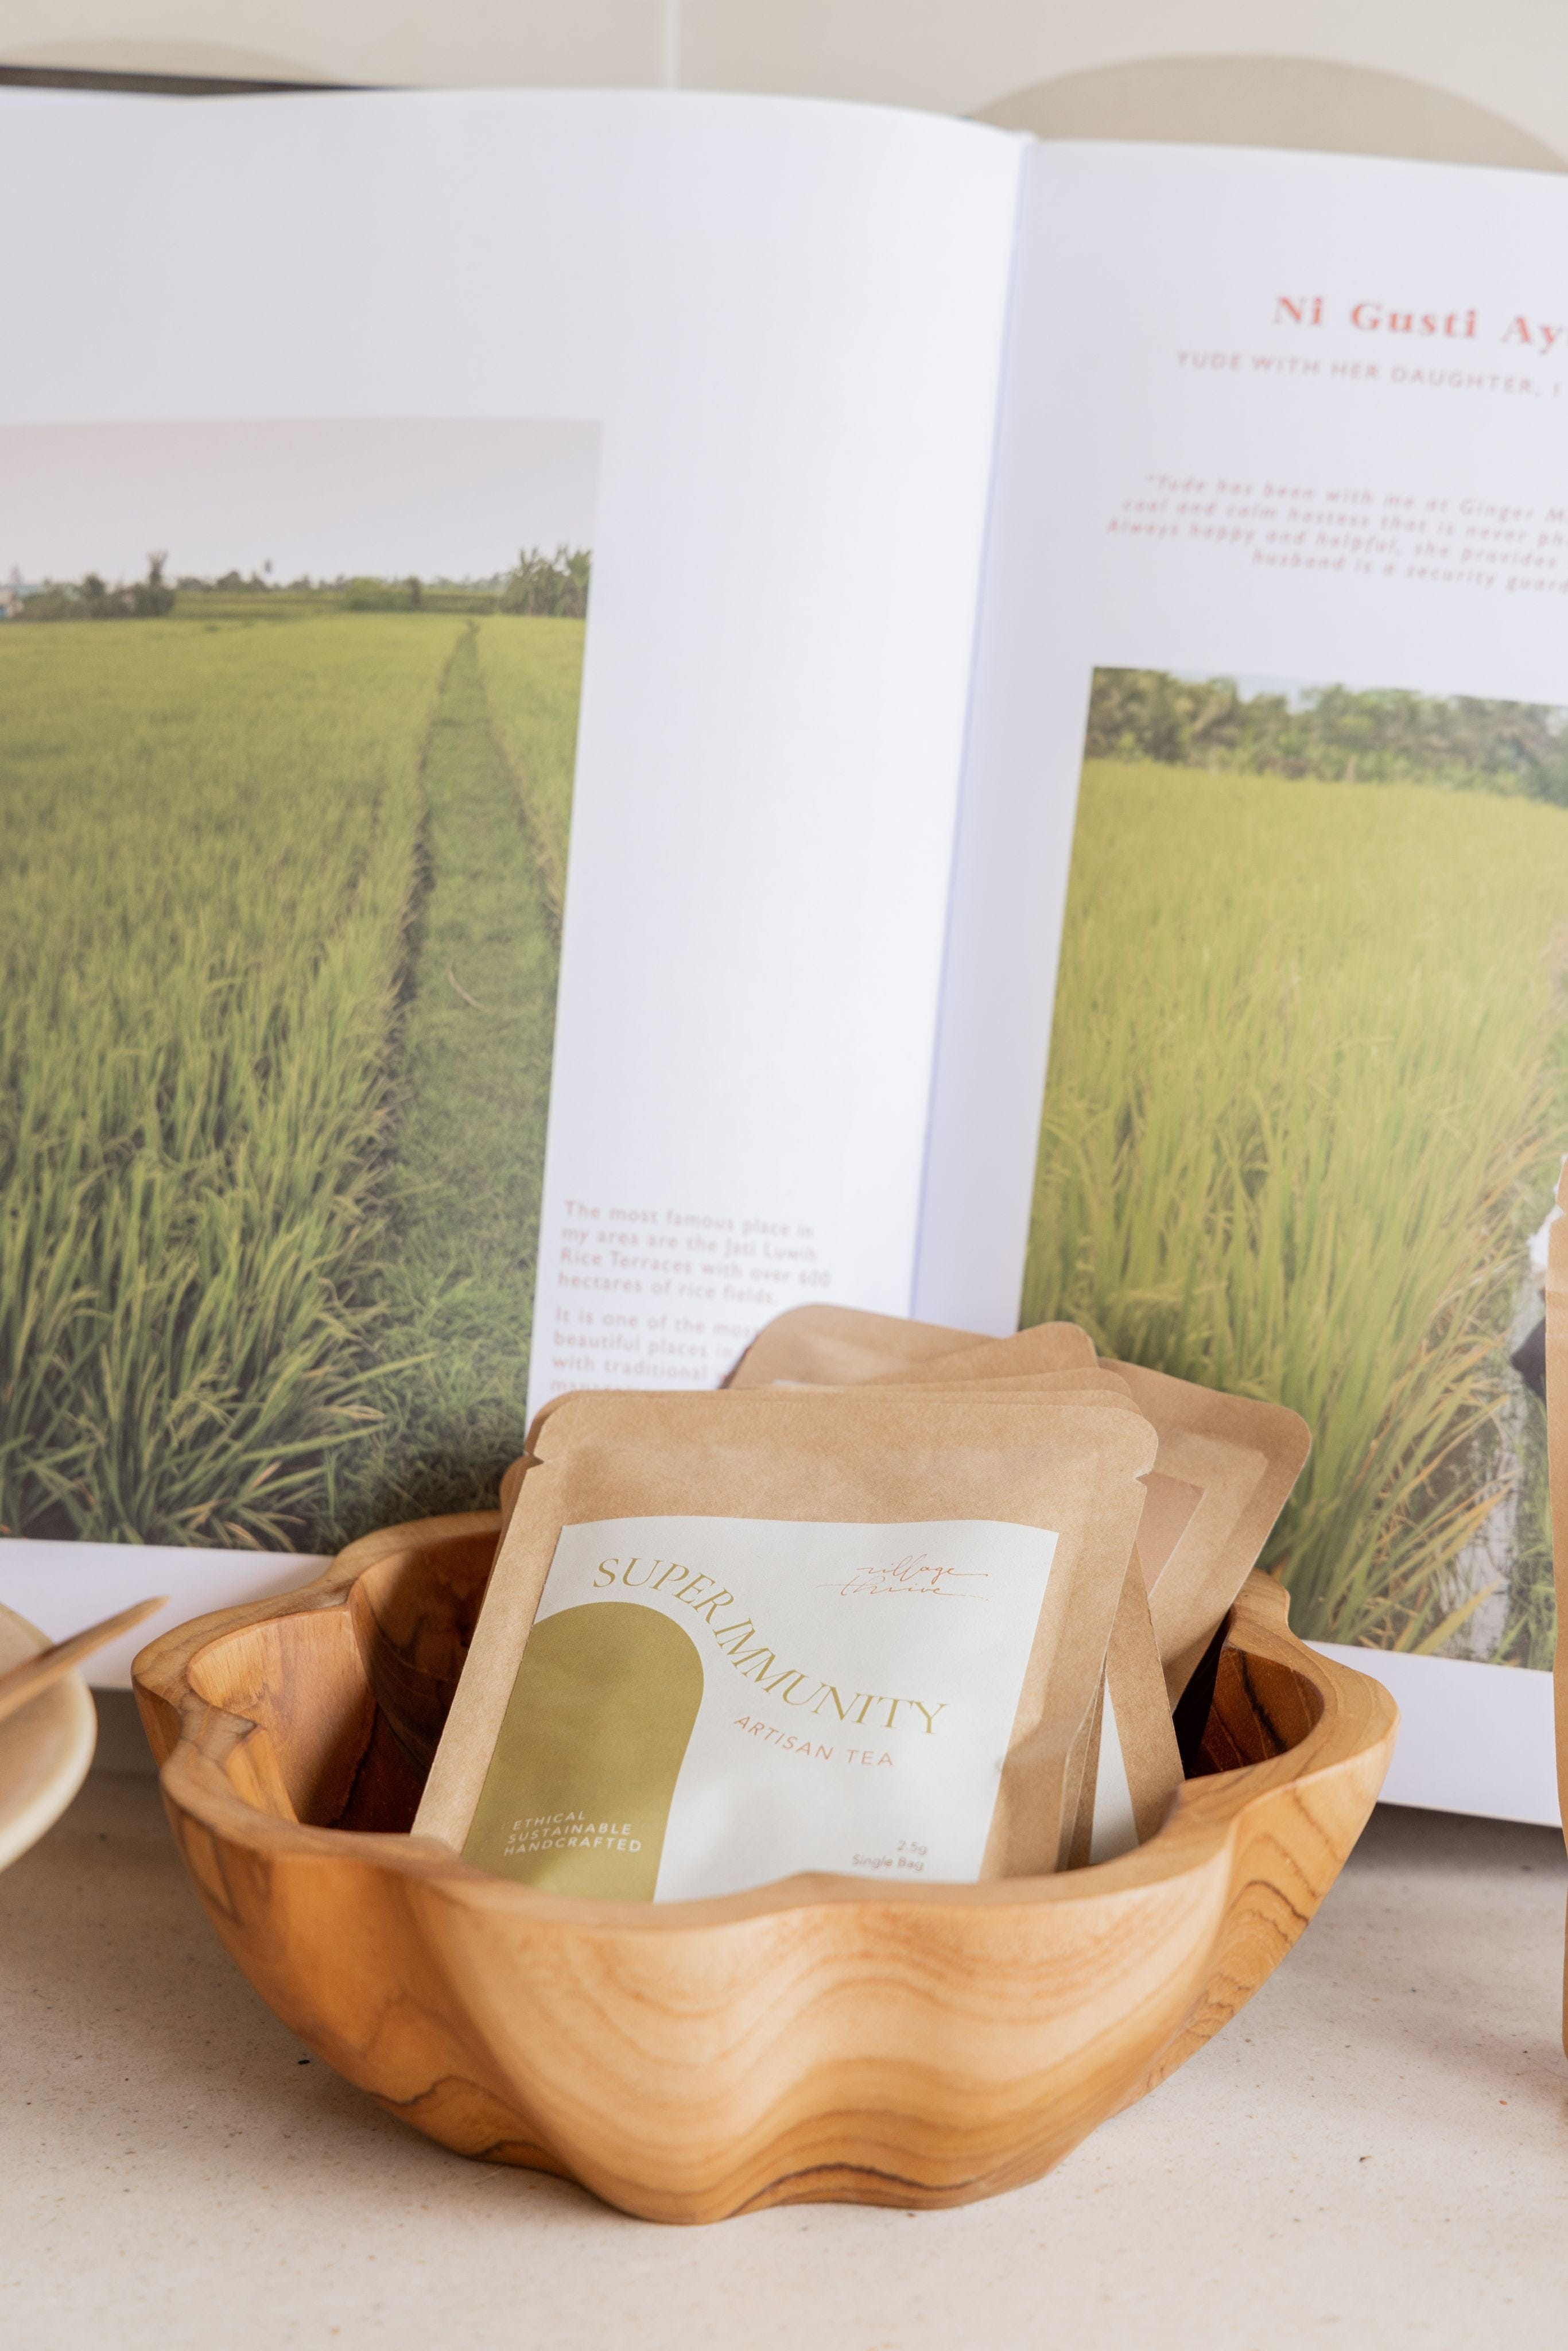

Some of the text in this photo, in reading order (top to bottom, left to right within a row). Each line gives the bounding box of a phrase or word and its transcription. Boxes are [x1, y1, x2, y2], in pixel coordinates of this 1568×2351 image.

[1274, 296, 1568, 355] Ni Gusti Ay
[1253, 356, 1319, 376] WITH
[1330, 362, 1379, 381] HER
[1217, 476, 1253, 495] has
[1263, 479, 1315, 499] been
[1326, 487, 1373, 506] with
[1384, 495, 1416, 509] me
[1425, 496, 1449, 513] at
[1458, 497, 1535, 523] Ginger
[1177, 502, 1217, 517] and
[1226, 502, 1278, 518] calm
[1287, 506, 1369, 529] hostess
[1380, 515, 1427, 533] that
[1437, 521, 1454, 537] is
[1465, 526, 1527, 542] never
[1536, 530, 1568, 549] ph
[1106, 517, 1179, 540] Always
[1190, 522, 1255, 546] happy
[1266, 529, 1307, 546] and
[1414, 540, 1450, 559] she
[1460, 547, 1557, 571] provides
[1253, 549, 1346, 572] husband
[1354, 558, 1373, 575] is
[1383, 562, 1396, 577] a
[1406, 564, 1497, 591] security
[564, 1200, 814, 1239] The most famous place in
[561, 1227, 589, 1244] my
[597, 1231, 639, 1246] area
[649, 1233, 678, 1249] are
[686, 1233, 717, 1252] the
[560, 1247, 602, 1266] Rice
[610, 1250, 692, 1274] Terraces
[701, 1261, 743, 1278] with
[750, 1267, 790, 1283] over
[558, 1271, 642, 1293] hectares
[650, 1278, 672, 1295] of
[679, 1282, 715, 1299] rice
[555, 1305, 570, 1323] It
[578, 1307, 593, 1325] is
[602, 1312, 639, 1328] one
[647, 1313, 666, 1330] of
[674, 1316, 705, 1333] the
[554, 1330, 640, 1352] beautiful
[649, 1339, 708, 1357] places
[552, 1355, 594, 1372] with
[604, 1359, 708, 1380] traditional
[593, 1557, 950, 1734] SUPER IMMUNITY
[733, 1716, 894, 1767] ARTISAN TEA
[507, 1822, 632, 1845] SUSTAINABLE
[513, 1810, 585, 1831] ETHICAL
[503, 1837, 642, 1856] HANDCRAFTED
[897, 1840, 927, 1855] 2.5g
[852, 1854, 924, 1872] Single Bag
